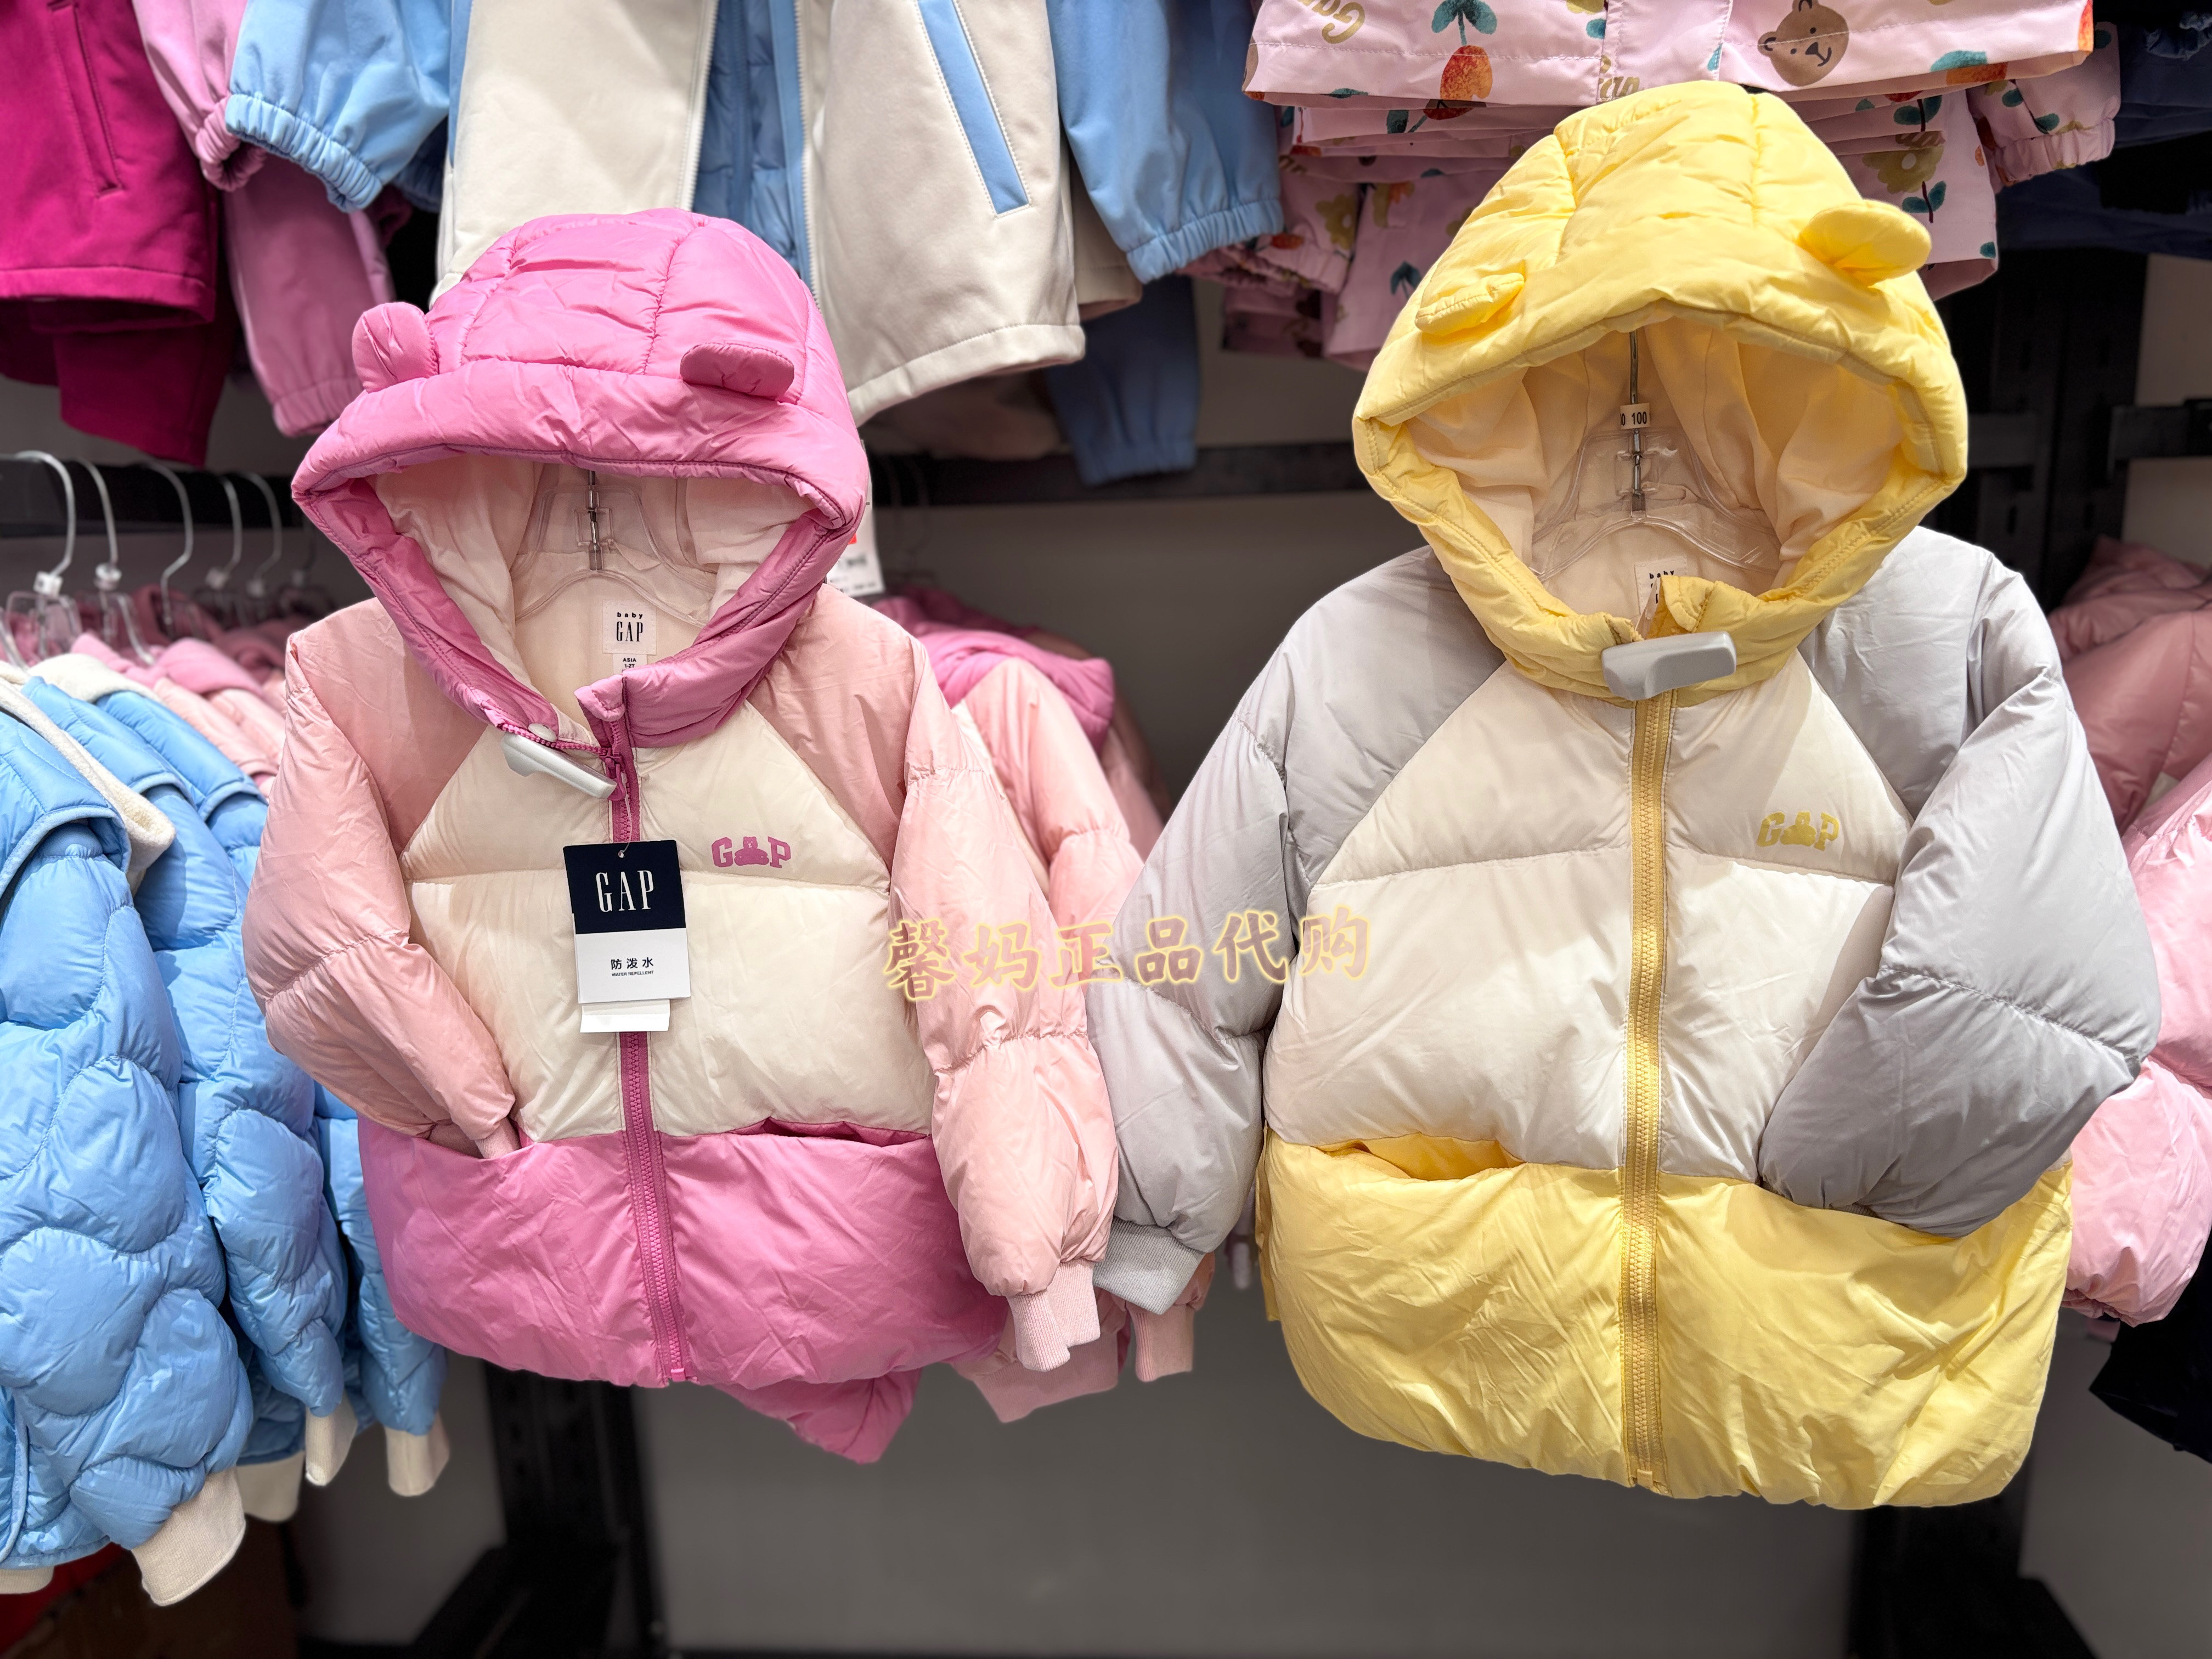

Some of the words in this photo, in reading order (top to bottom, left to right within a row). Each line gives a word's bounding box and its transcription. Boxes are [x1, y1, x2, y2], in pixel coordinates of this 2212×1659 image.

[1632, 411, 1647, 425] 100
[616, 621, 643, 642] GAP
[596, 870, 654, 912] GAP
[611, 957, 653, 970] 防泼水
